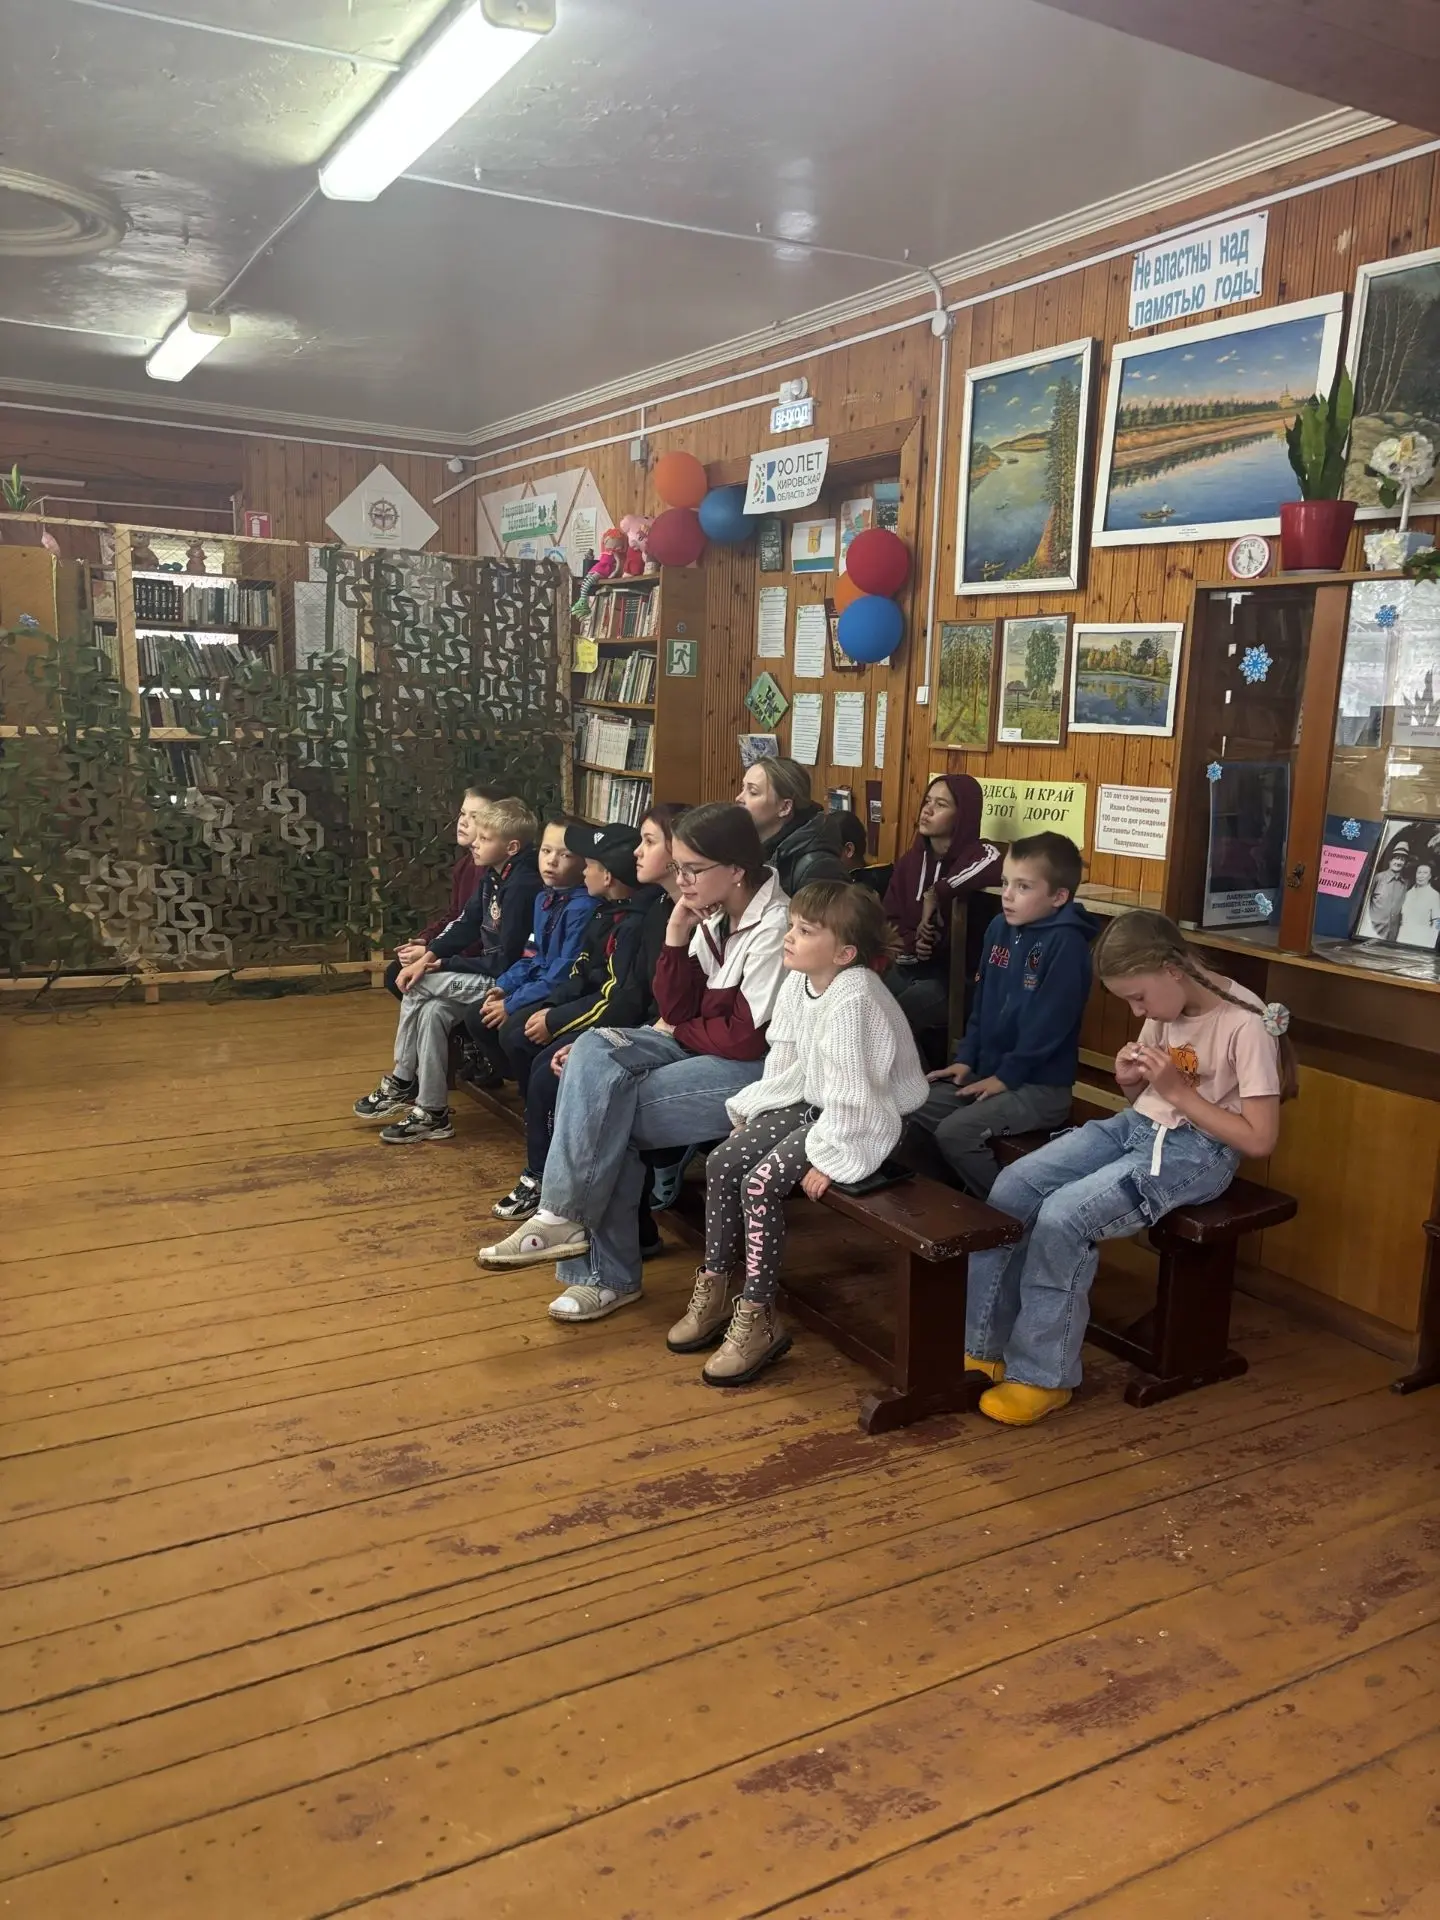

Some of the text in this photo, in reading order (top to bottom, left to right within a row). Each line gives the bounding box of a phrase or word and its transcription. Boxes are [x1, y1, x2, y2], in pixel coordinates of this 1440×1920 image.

[1134, 229, 1250, 292] Не властны над
[1134, 267, 1259, 326] памятью годы
[775, 403, 809, 427] ВЫХОД
[777, 451, 823, 476] 90 ЛЕТ
[776, 473, 821, 490] КИРОВСКАЯ
[983, 784, 1075, 803] ЗДЕСЬ, И КРАЙ
[985, 804, 1070, 822] ЭТОТ ДОРОГ
[1318, 878, 1351, 890] ШКОВЫ
[745, 1152, 785, 1277] WHAT'S UP?
